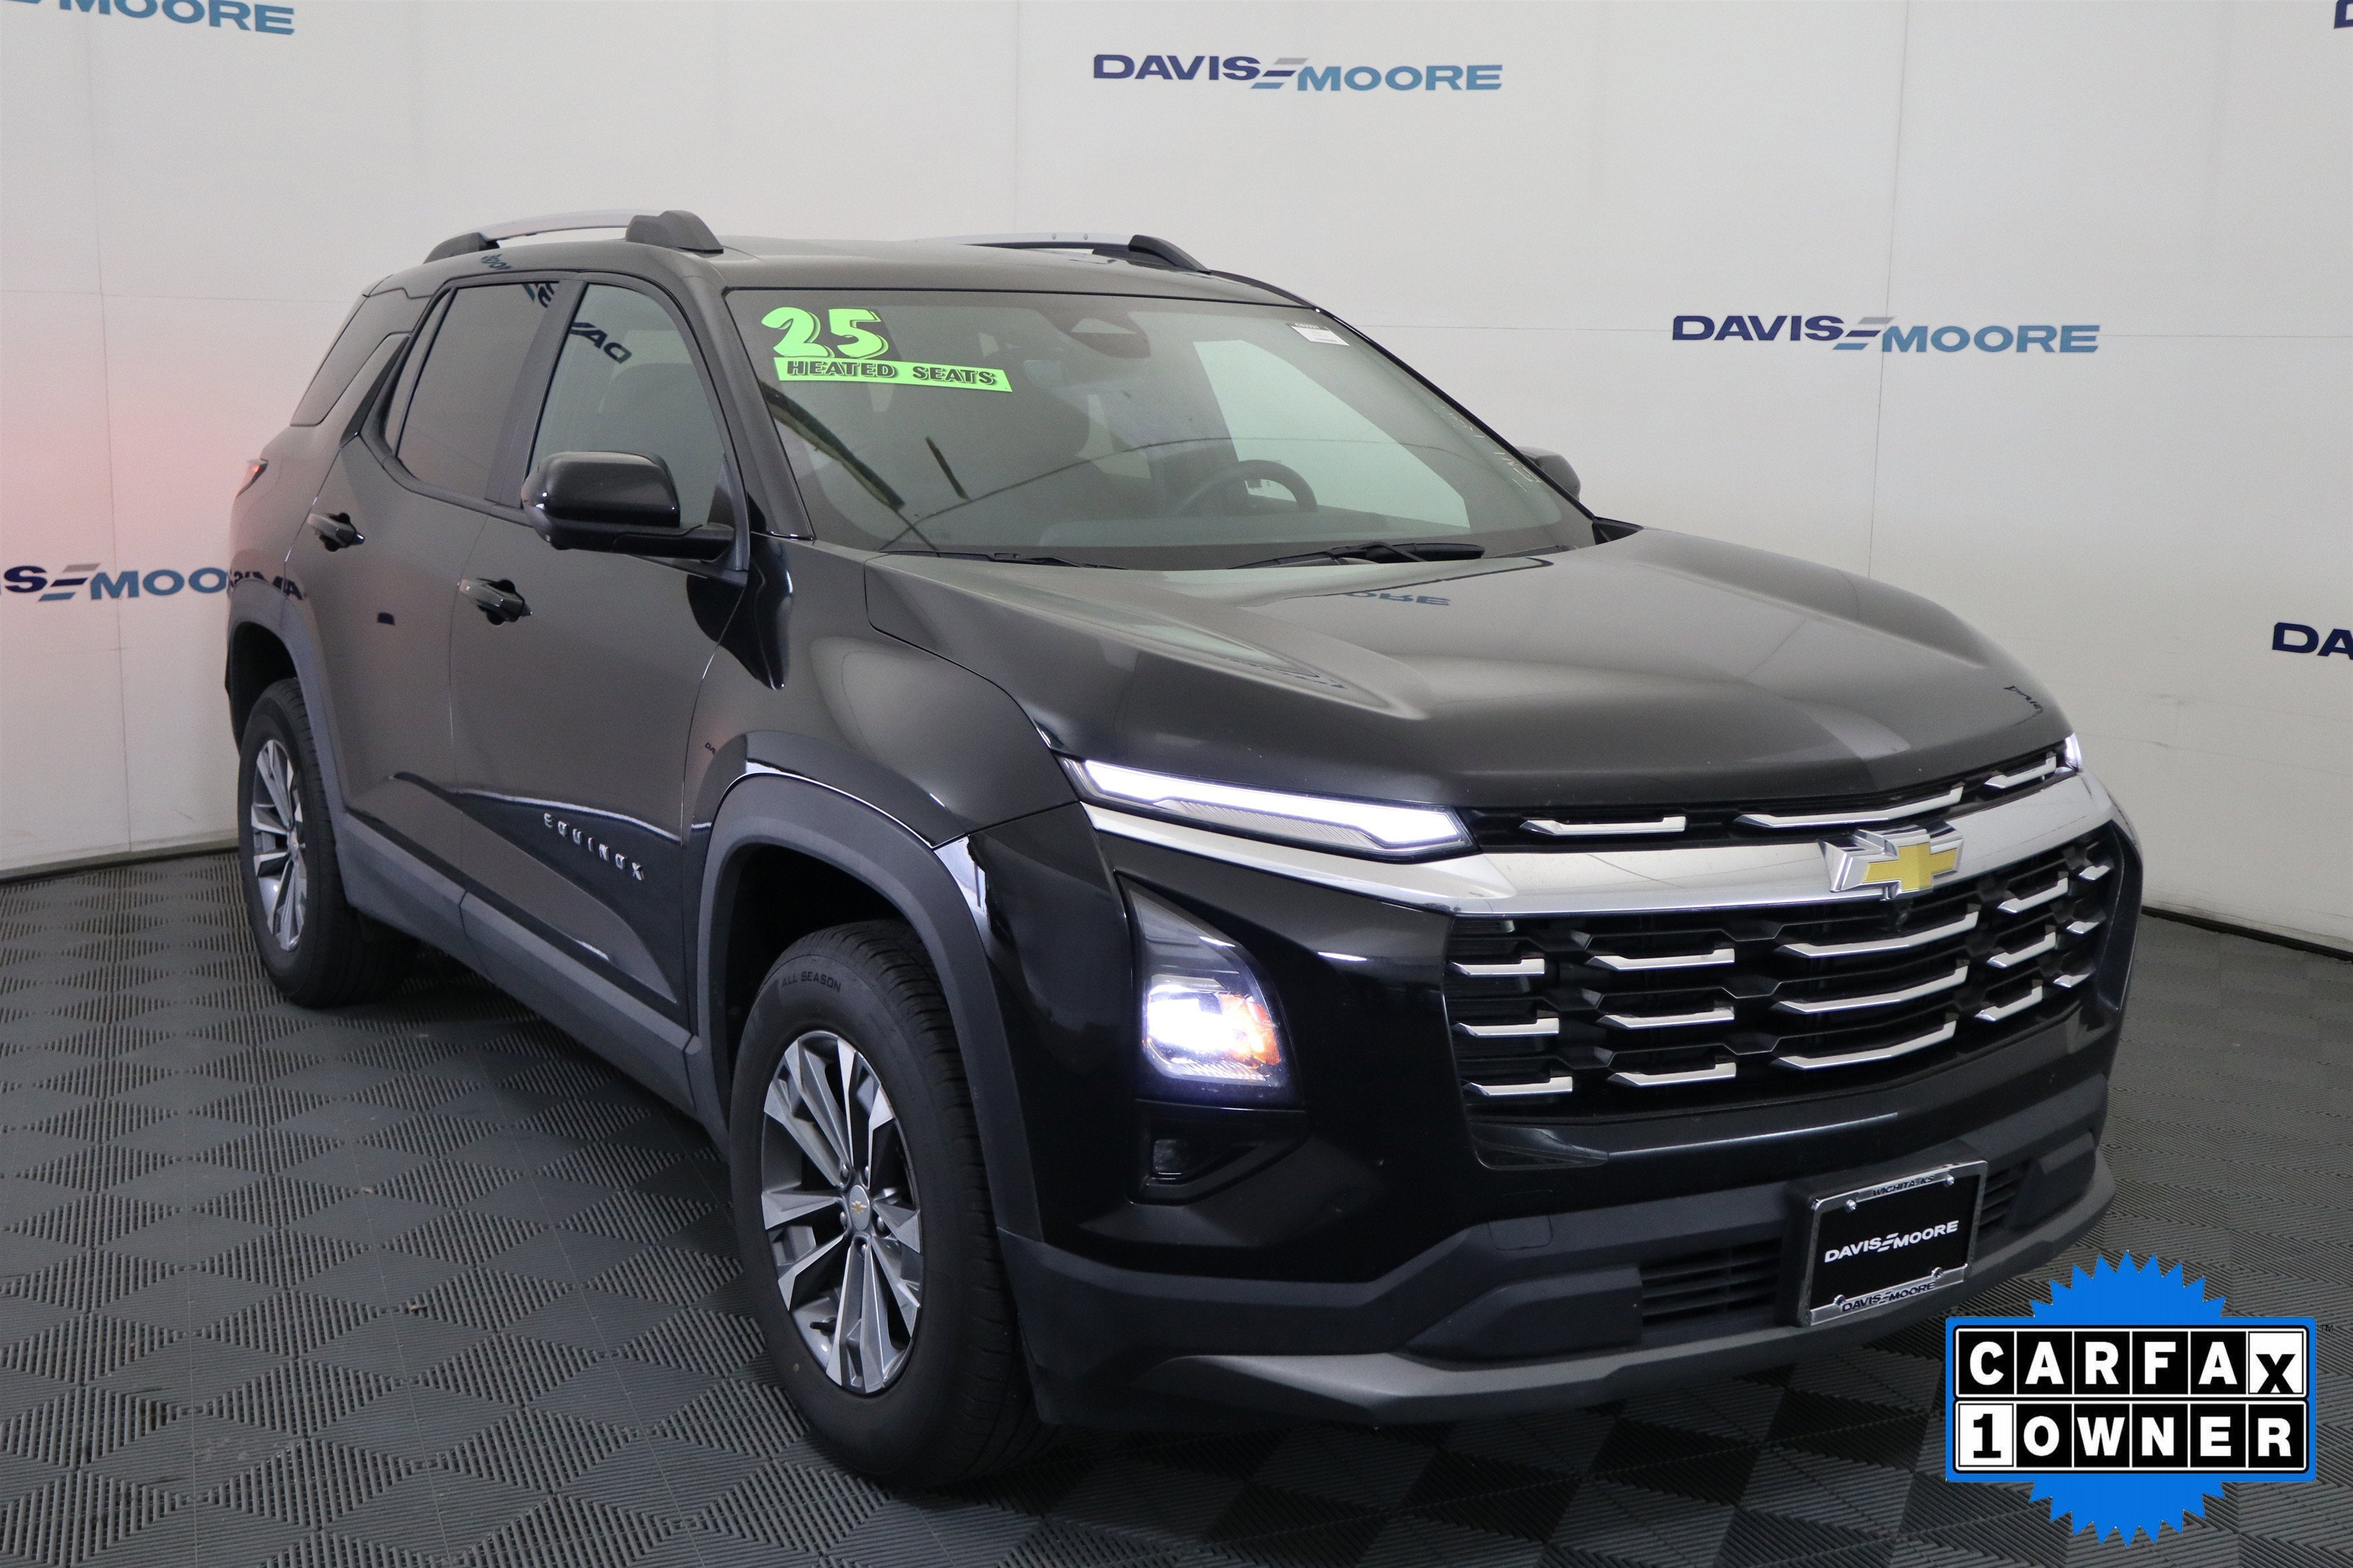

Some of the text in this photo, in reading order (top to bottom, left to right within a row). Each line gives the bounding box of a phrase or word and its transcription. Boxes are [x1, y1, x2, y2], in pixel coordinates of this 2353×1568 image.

[1297, 64, 1503, 92] MOORE
[761, 307, 889, 359] 25
[1881, 325, 2101, 353] MOORE
[786, 360, 996, 385] HEATED SEATS
[90, 567, 227, 600] MOO
[543, 812, 645, 880] EQUINOX
[782, 971, 842, 992] ALL SEASON
[1873, 1175, 1934, 1196] WICHITA KS
[1893, 1220, 1959, 1249] MOORE
